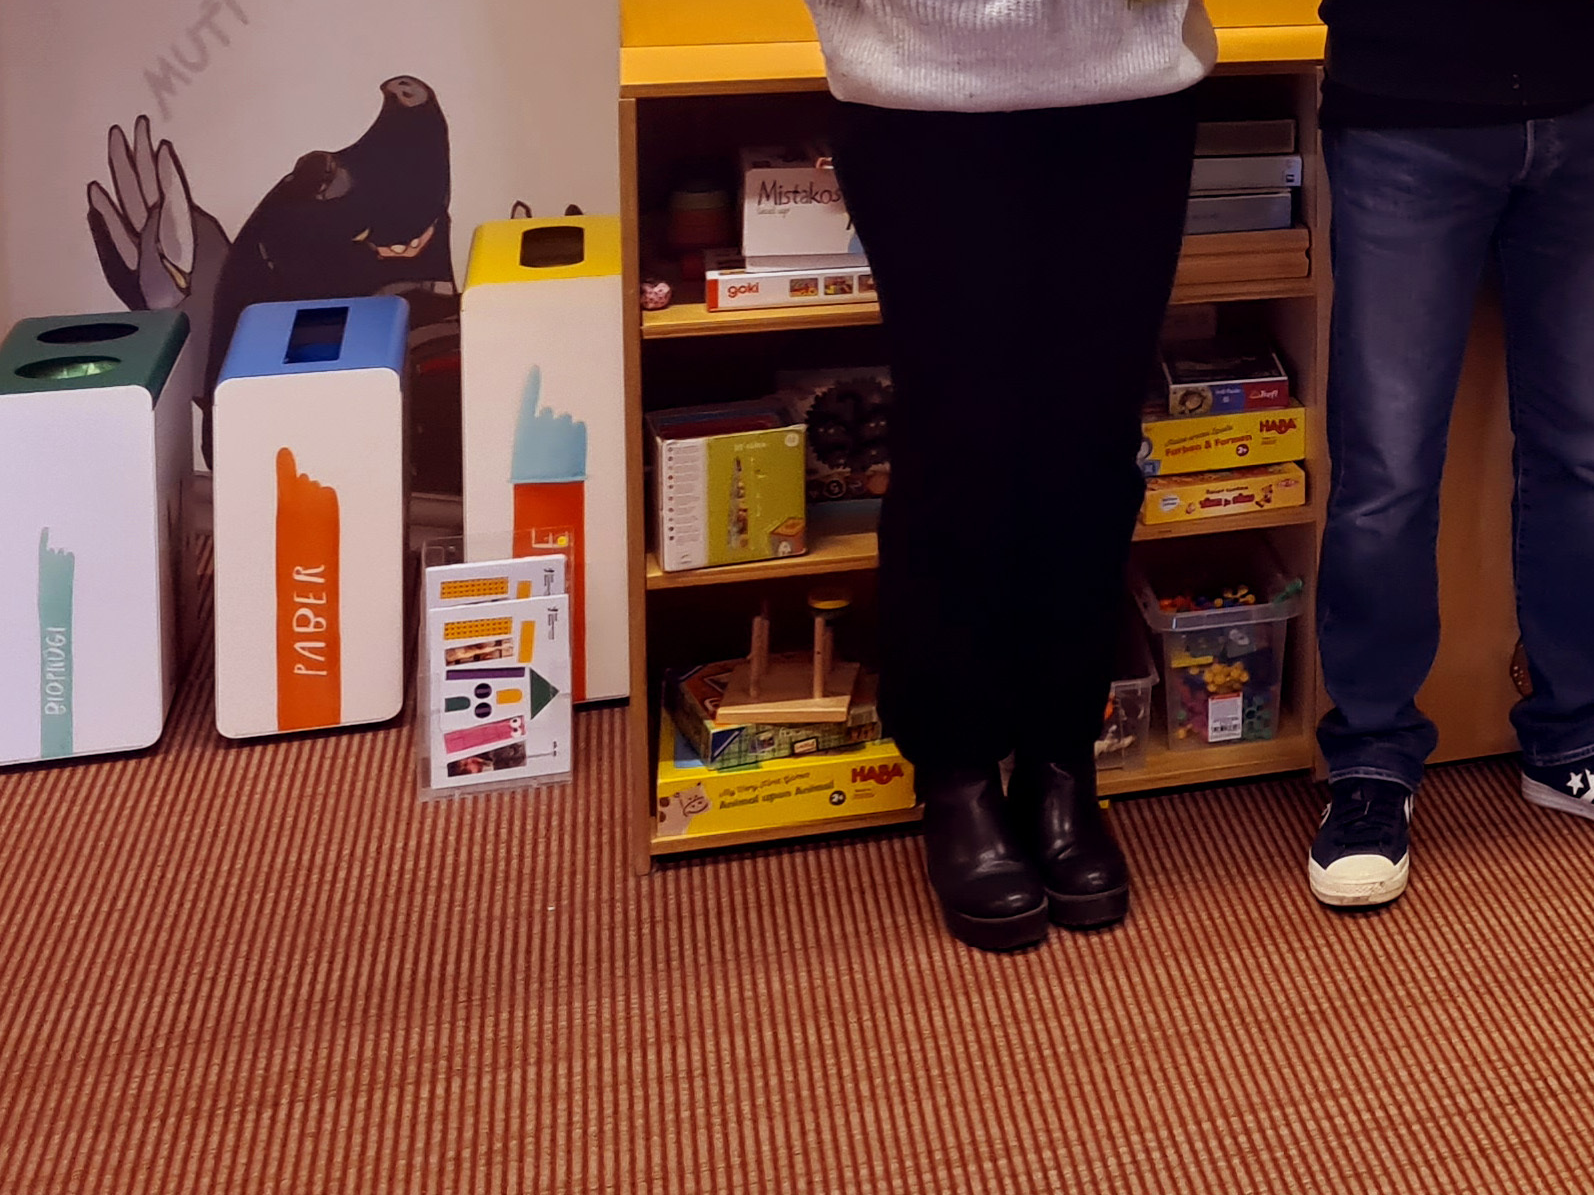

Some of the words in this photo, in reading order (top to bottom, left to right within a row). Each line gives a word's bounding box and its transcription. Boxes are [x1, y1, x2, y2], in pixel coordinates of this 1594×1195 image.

[727, 282, 760, 299] goki
[1259, 417, 1297, 434] HABA
[1204, 440, 1212, 449] &
[292, 564, 328, 676] PABER
[851, 762, 904, 786] HABA
[719, 794, 759, 810] Animal
[794, 779, 835, 797] Animal
